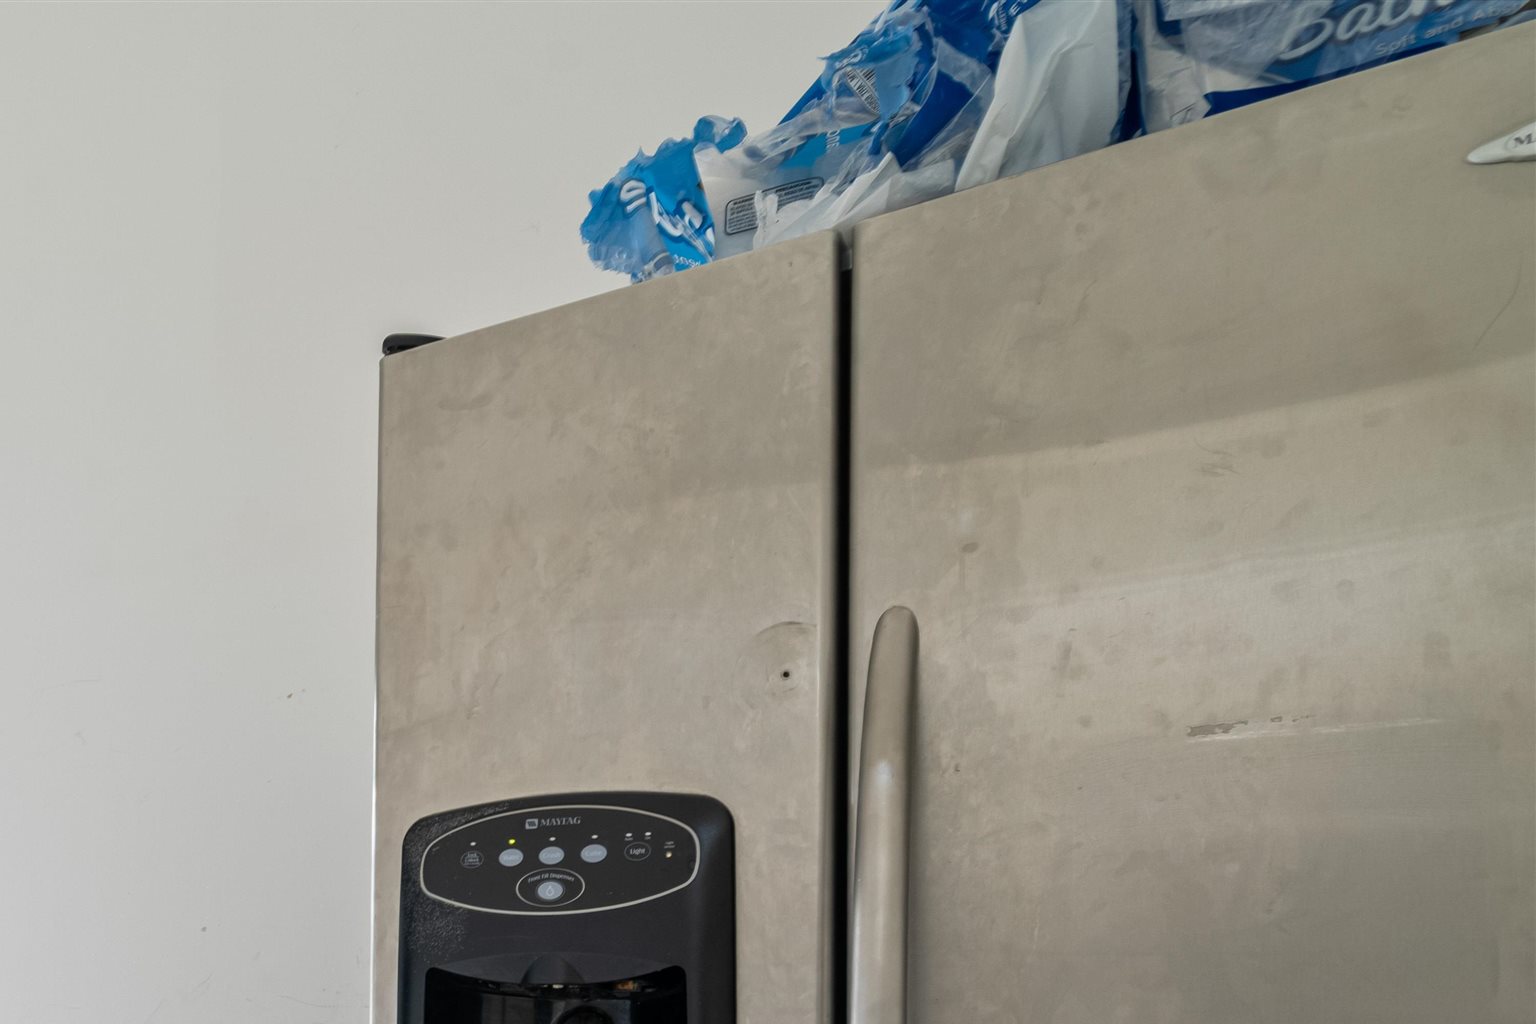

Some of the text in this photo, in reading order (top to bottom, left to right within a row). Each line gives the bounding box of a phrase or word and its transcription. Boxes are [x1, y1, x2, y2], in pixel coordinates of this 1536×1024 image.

[1373, 34, 1418, 57] Soft
[1423, 16, 1464, 39] and
[539, 816, 582, 827] MAYTAG
[629, 847, 646, 856] Light
